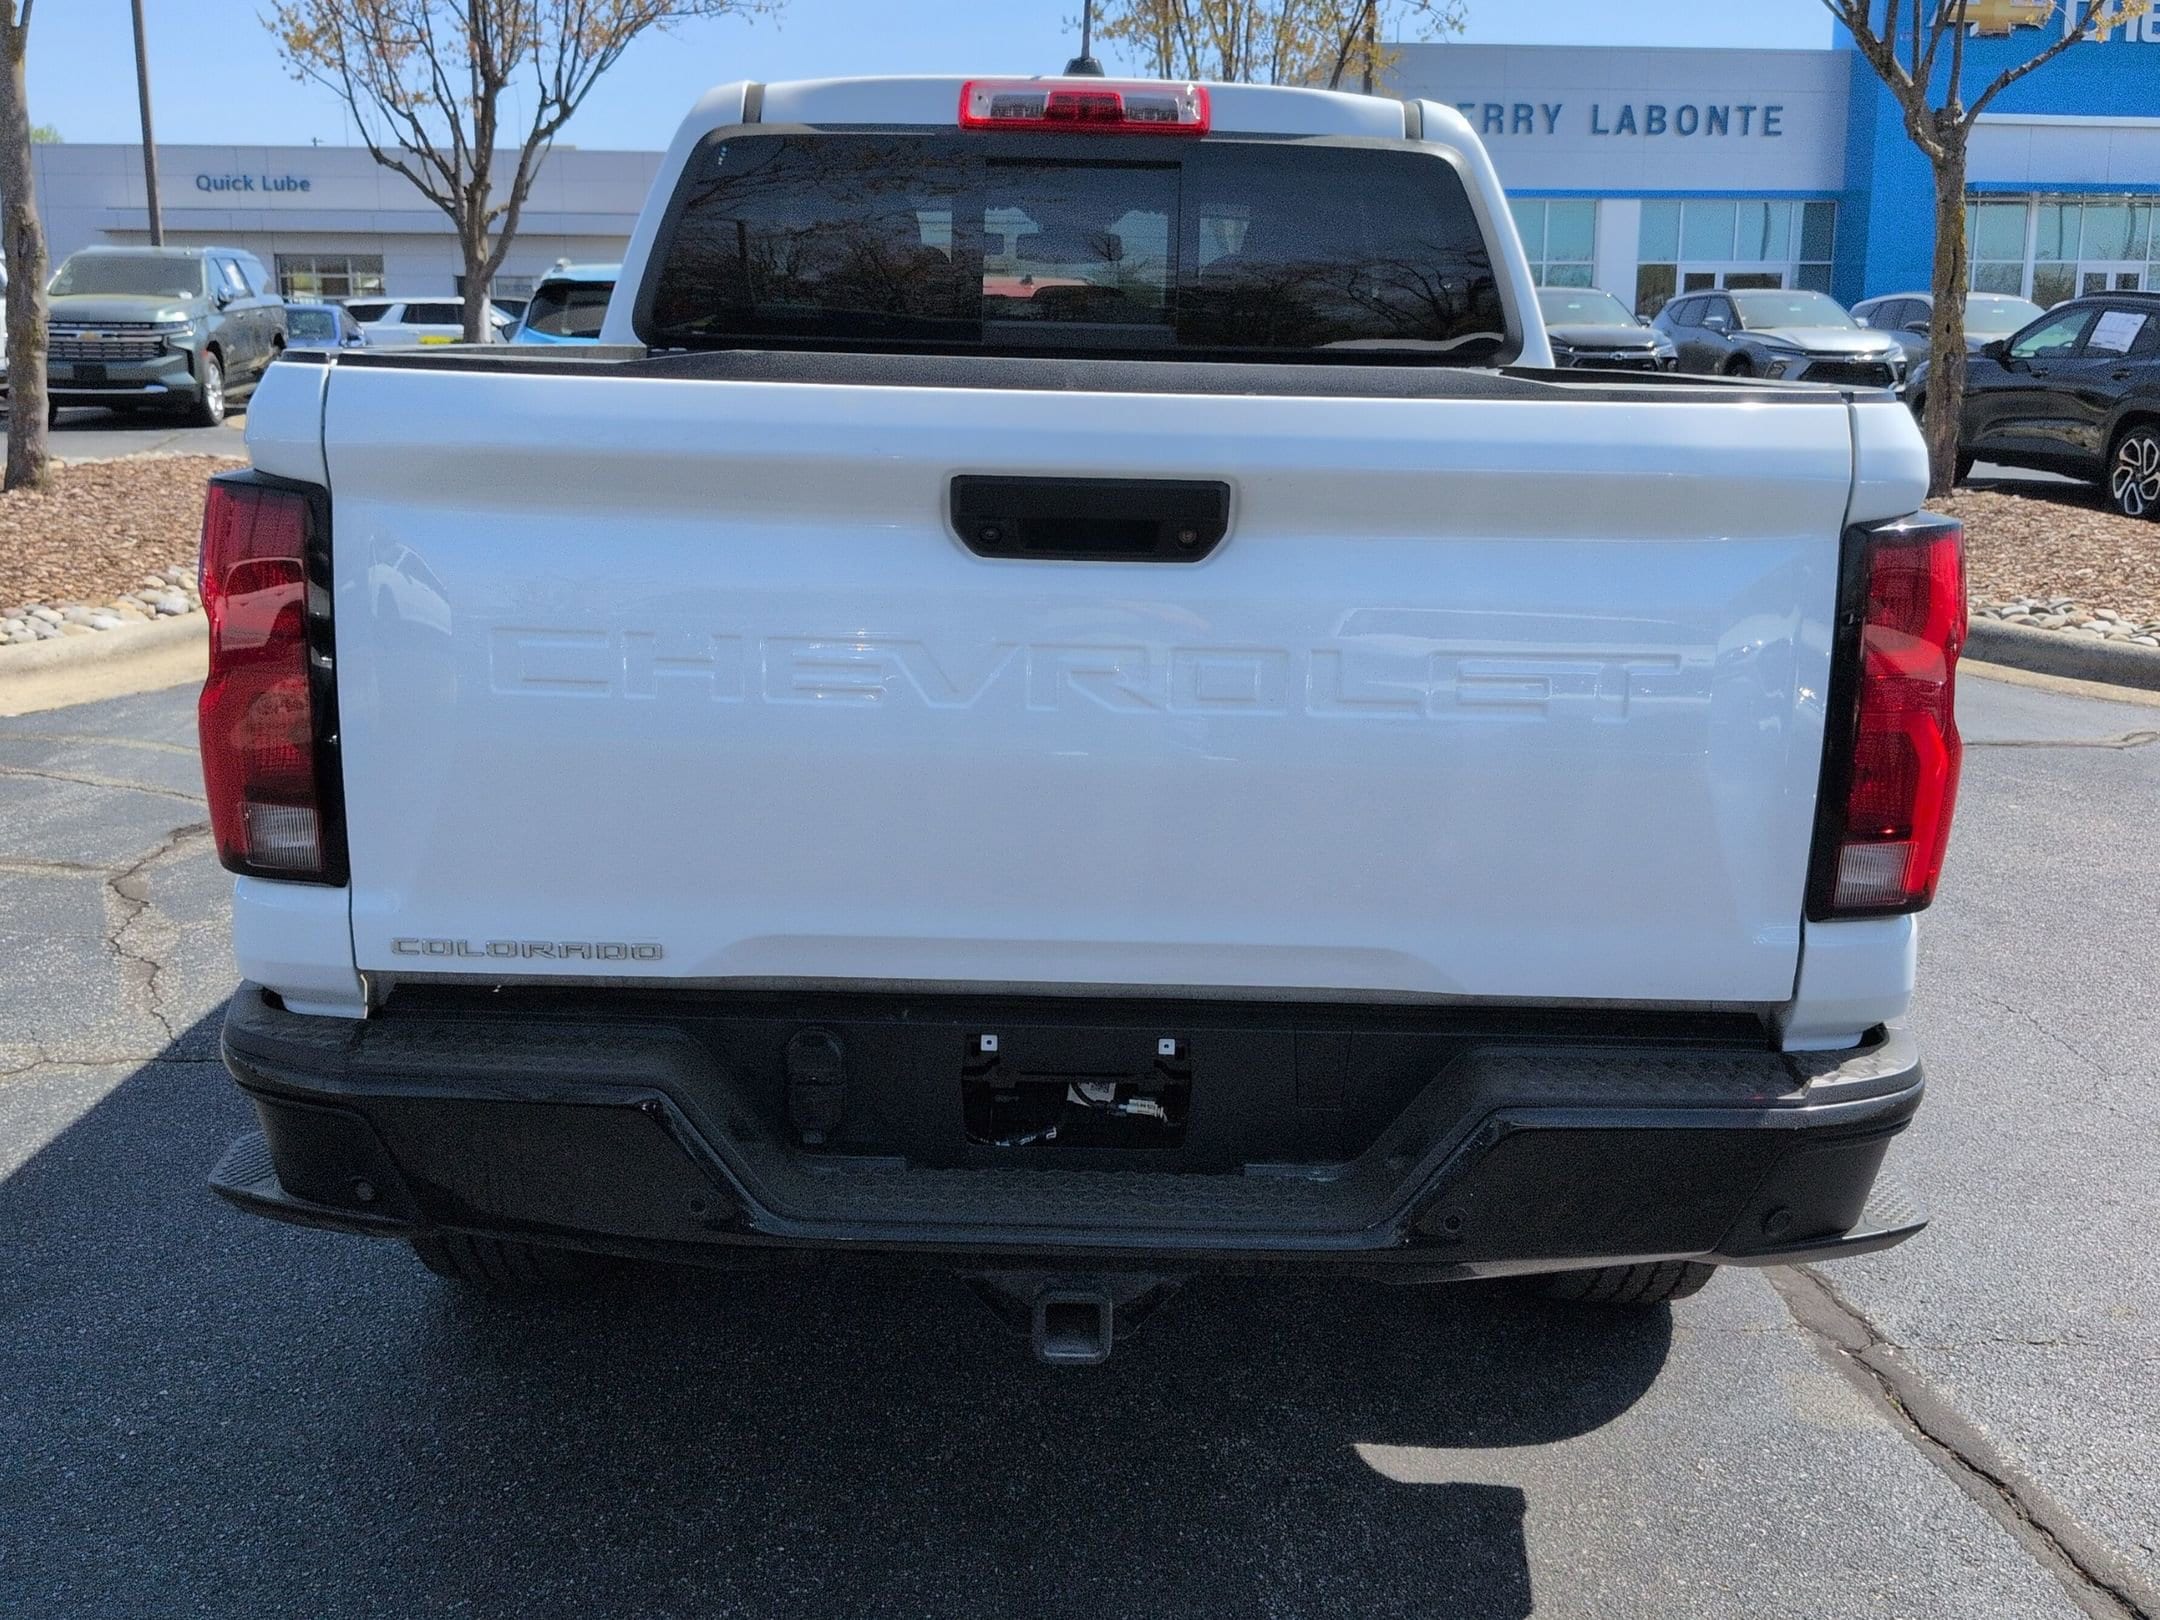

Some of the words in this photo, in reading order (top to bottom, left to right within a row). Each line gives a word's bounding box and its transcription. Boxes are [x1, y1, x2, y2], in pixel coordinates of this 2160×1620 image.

[1590, 104, 1784, 137] LABONTE
[195, 174, 255, 192] Quick
[262, 175, 312, 192] Lube
[490, 627, 1683, 725] CHEVROLET
[390, 937, 664, 961] COLORADO
